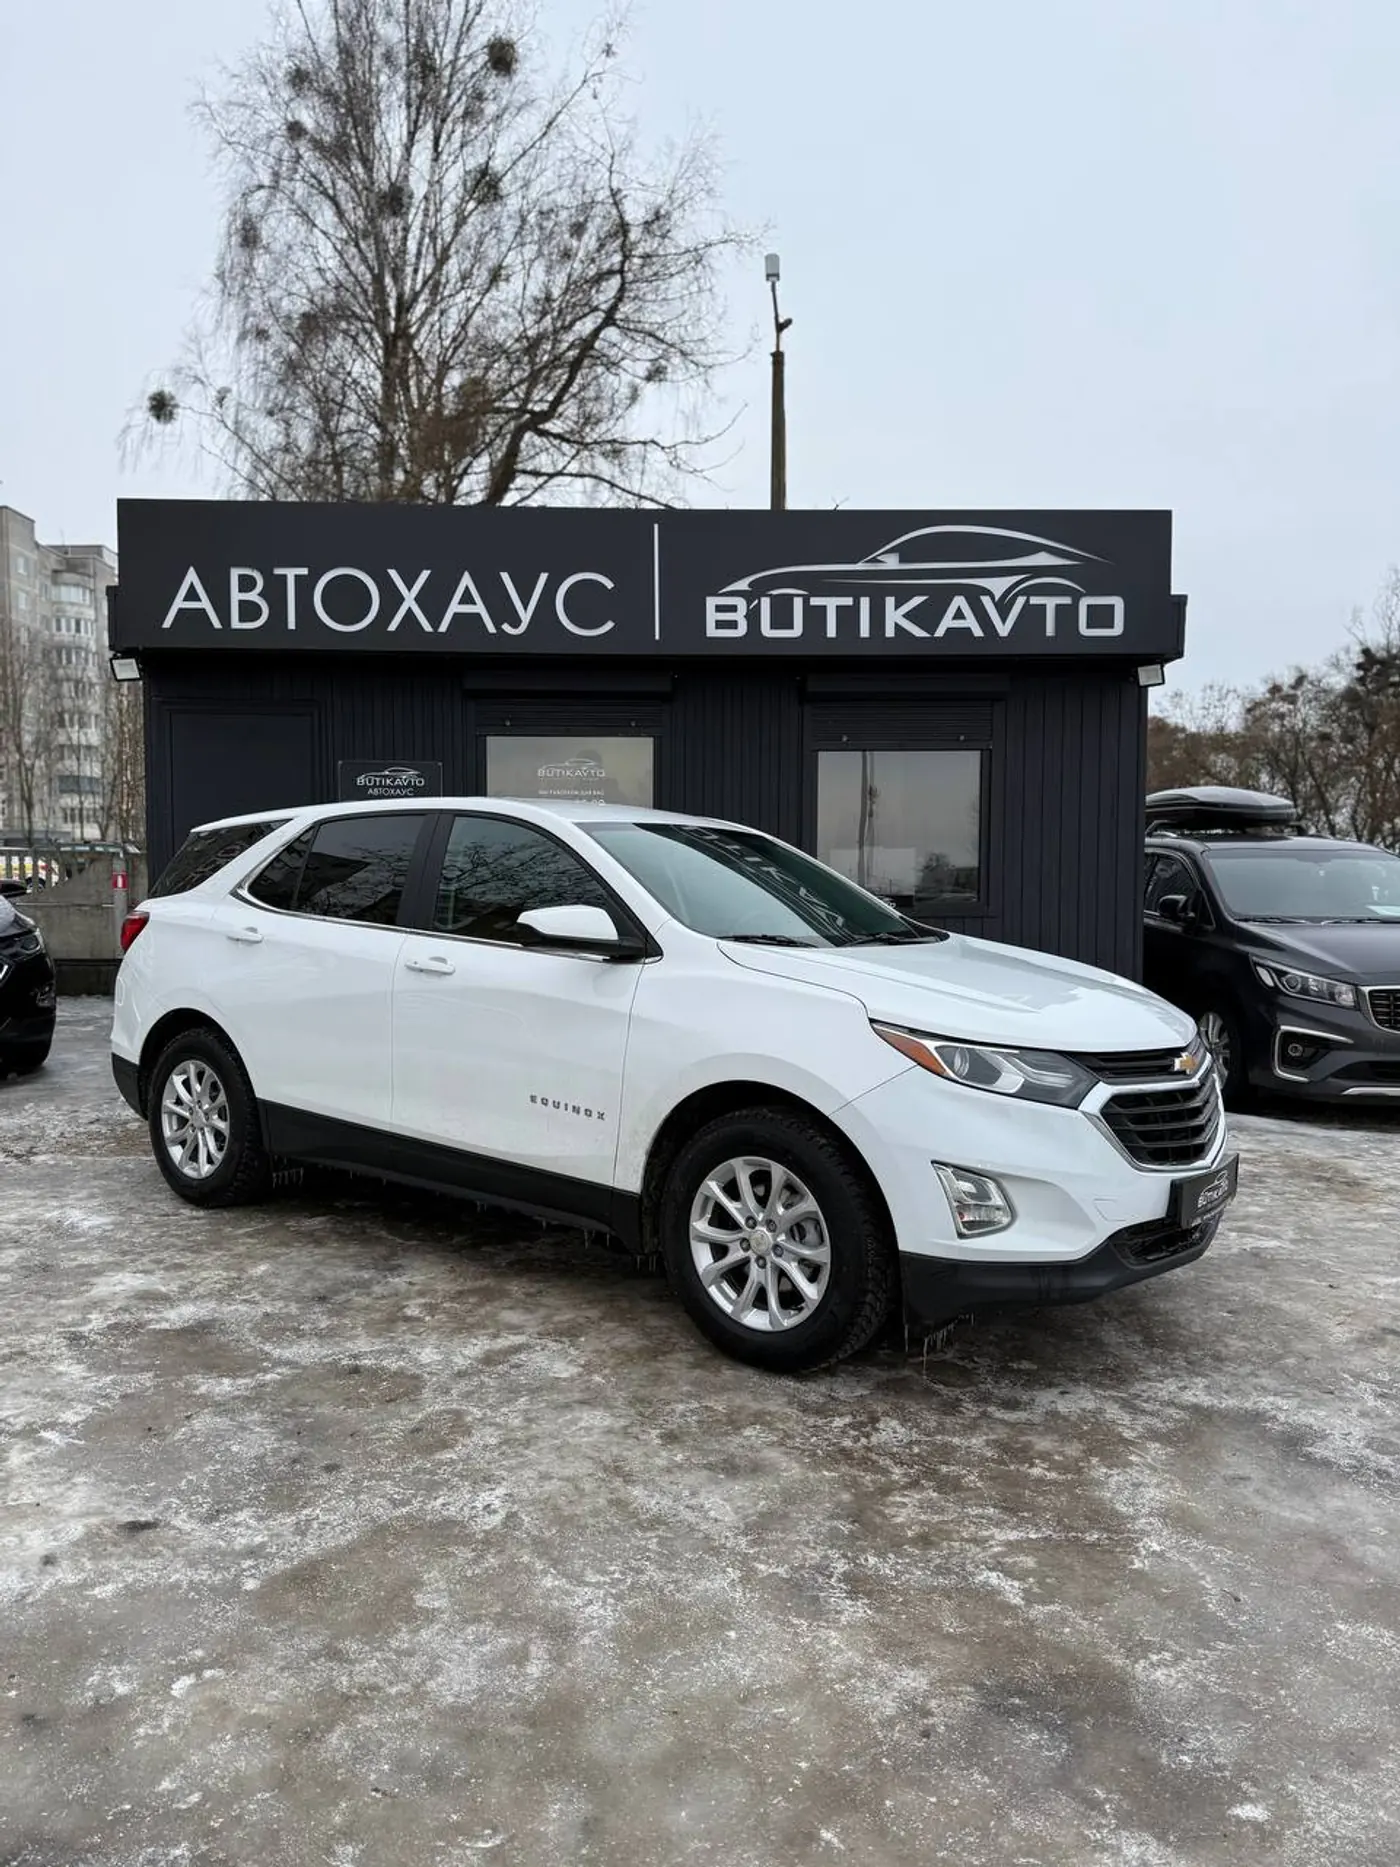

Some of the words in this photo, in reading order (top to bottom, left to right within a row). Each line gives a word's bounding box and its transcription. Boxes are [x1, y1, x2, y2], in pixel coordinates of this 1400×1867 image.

[161, 566, 615, 637] АВТОХАУС
[705, 596, 1125, 638] BUTIKAVTO
[356, 775, 425, 786] BUTIKAVTO
[537, 768, 605, 777] BUTIKAVTO
[367, 788, 414, 796] АВТОХАУС
[529, 1094, 606, 1121] EQUINOX
